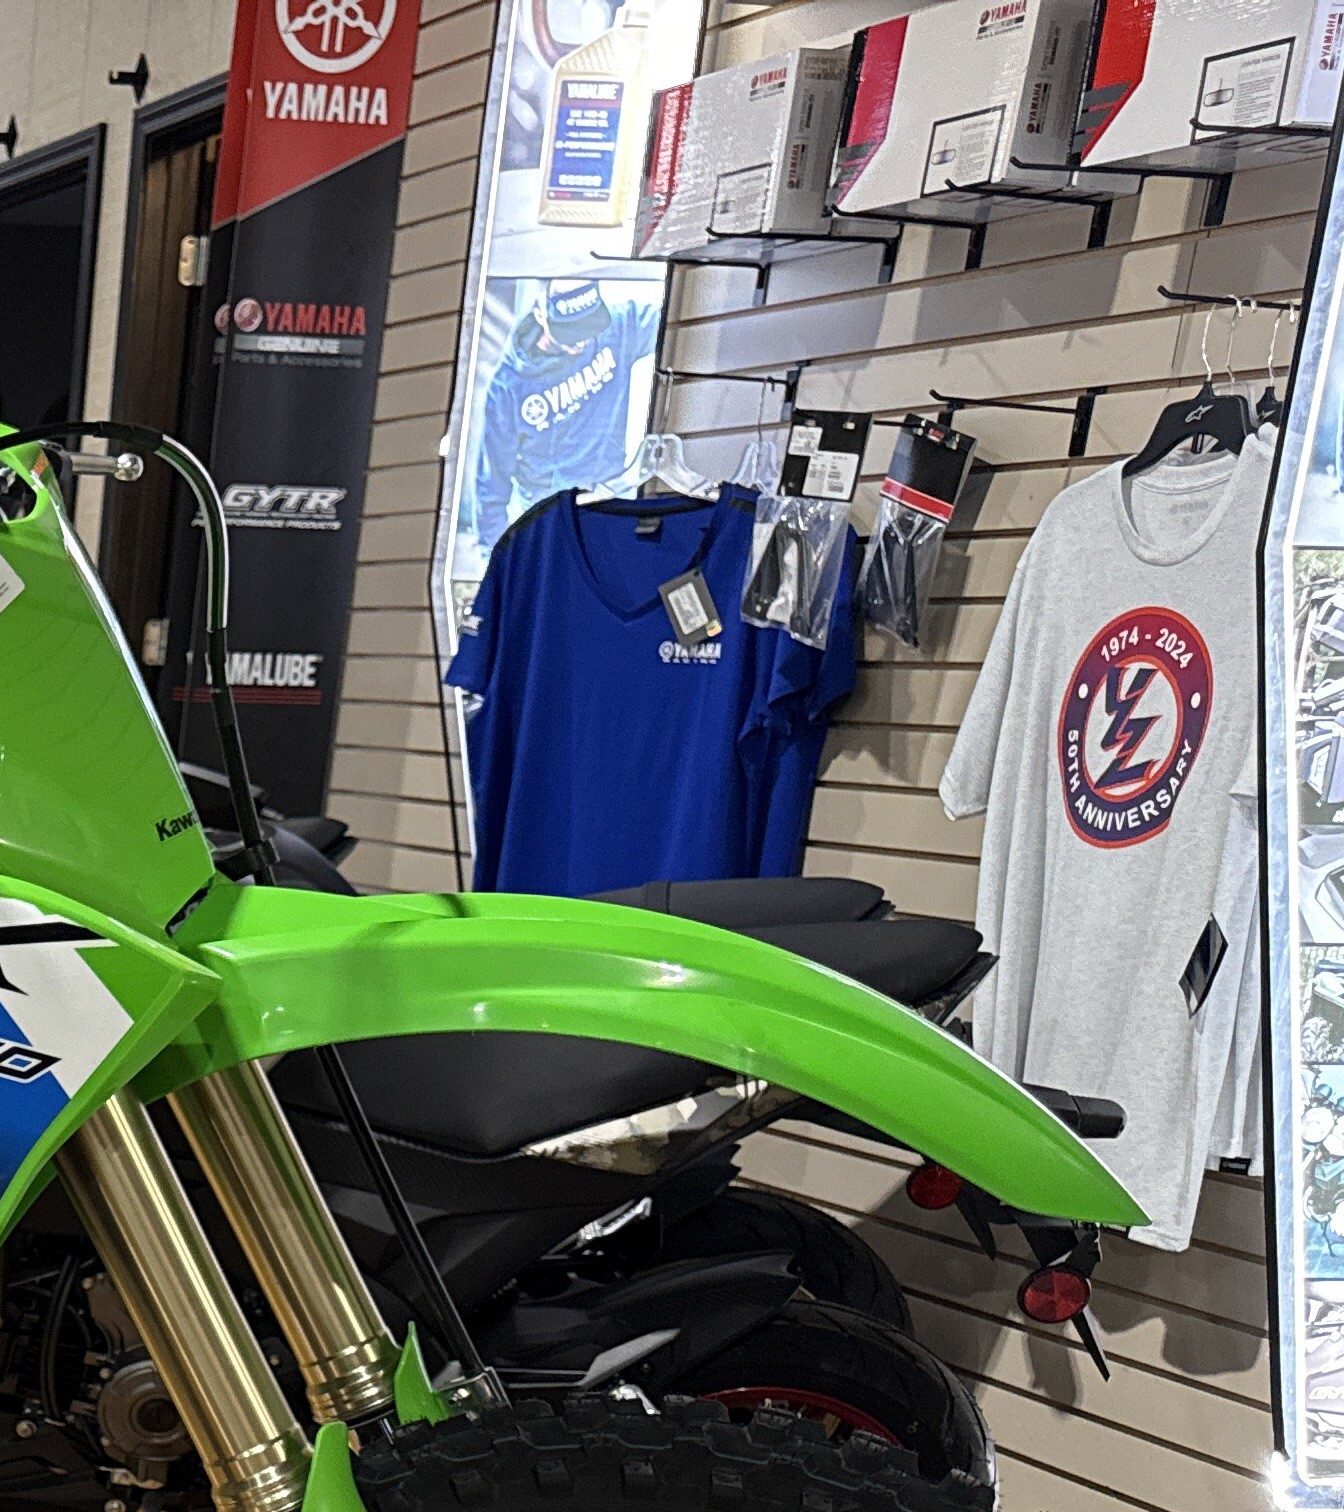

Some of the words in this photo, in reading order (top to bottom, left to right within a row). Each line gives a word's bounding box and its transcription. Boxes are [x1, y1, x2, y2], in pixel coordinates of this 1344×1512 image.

[1321, 12, 1338, 58] YAMAHA
[263, 80, 389, 126] YAMAHA
[1028, 82, 1043, 121] YAMAHA
[263, 301, 367, 336] YAMAHA
[543, 346, 617, 413] YAMAHA
[222, 484, 347, 515] GYTR
[1100, 625, 1140, 662] 1974
[1154, 627, 1194, 669] 2024
[1066, 729, 1081, 793] 50TH
[1074, 739, 1192, 832] ANNIVERSARY
